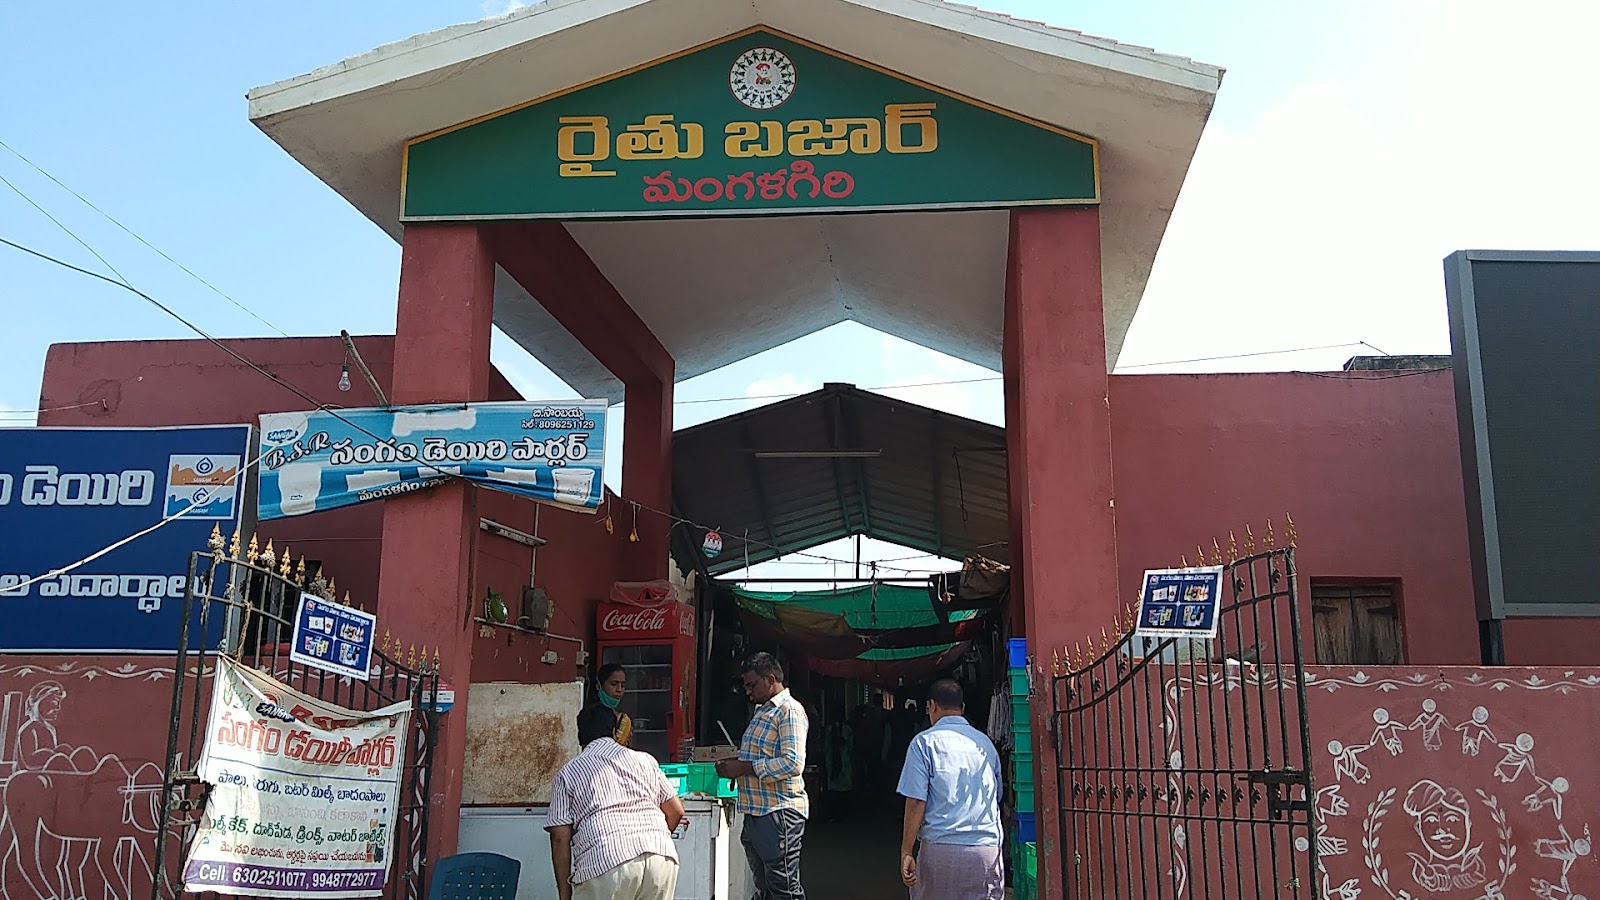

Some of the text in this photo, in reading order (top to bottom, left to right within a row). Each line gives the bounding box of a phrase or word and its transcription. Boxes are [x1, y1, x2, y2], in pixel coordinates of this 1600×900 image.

[557, 103, 939, 178] రైతు బజార్
[642, 160, 856, 203] మంగళగిరి
[539, 420, 595, 430] 8096251129
[330, 437, 418, 465] సంగం
[511, 434, 588, 466] పార్లర్
[602, 607, 669, 632] Coca-Cola
[232, 867, 310, 889] 6302511077,
[312, 872, 377, 888] 9948772977
